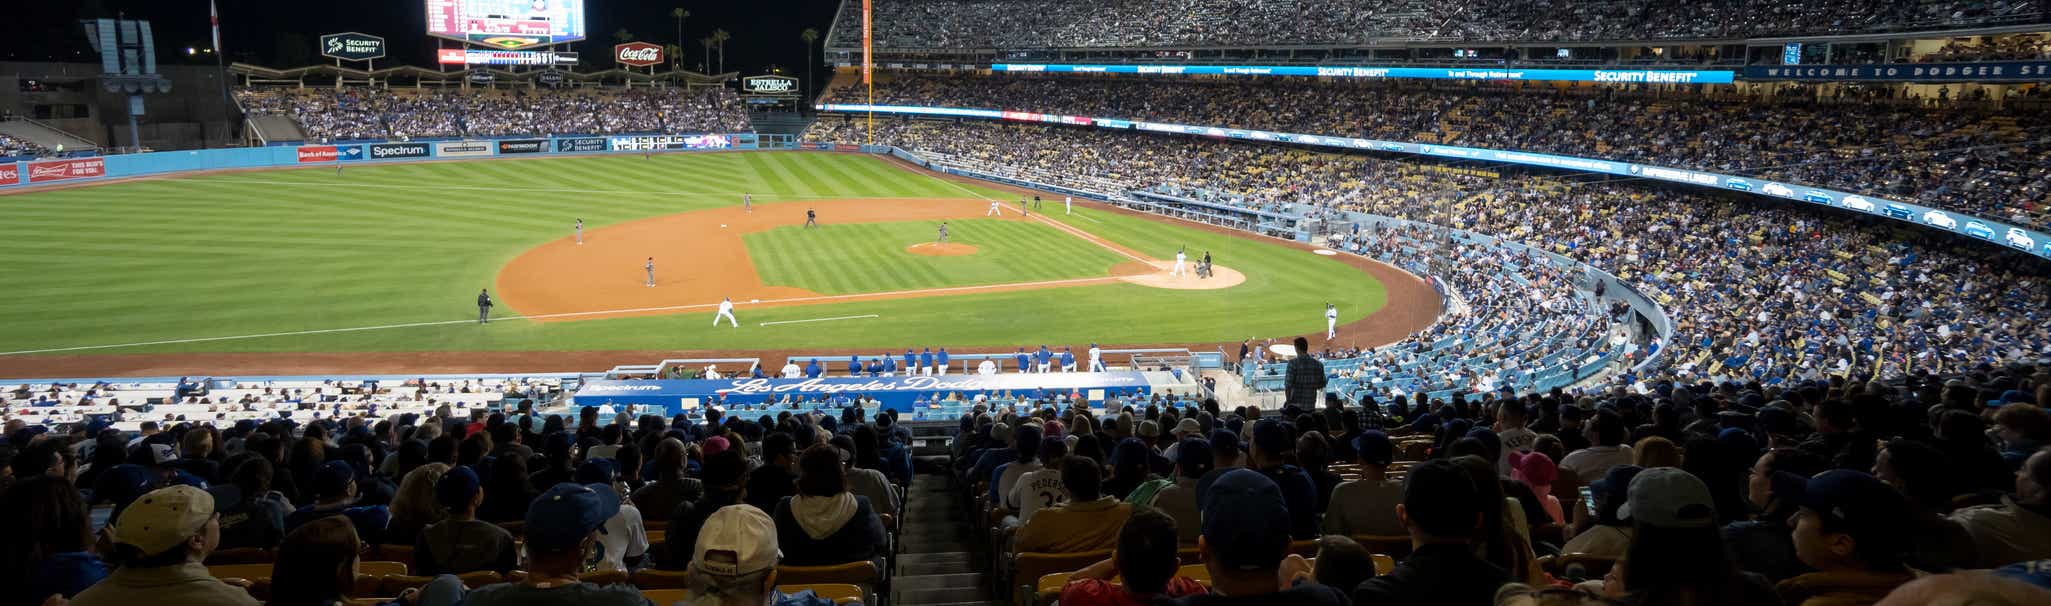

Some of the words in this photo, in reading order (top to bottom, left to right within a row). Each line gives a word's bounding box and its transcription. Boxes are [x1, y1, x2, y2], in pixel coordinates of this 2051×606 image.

[346, 39, 380, 47] SECURITY
[1137, 65, 1161, 73] SECURITY
[1317, 67, 1352, 77] SECURITY
[1768, 68, 1858, 77] WELCOME
[1875, 68, 1897, 76] TO
[1914, 66, 2003, 76] DODGER
[1466, 70, 1488, 79] Through
[1594, 71, 1645, 82] SECURITY
[574, 138, 604, 146] SECURITY
[322, 149, 347, 157] America
[373, 145, 424, 157] Spectrum
[715, 378, 772, 395] Los
[773, 377, 896, 394] Angeles
